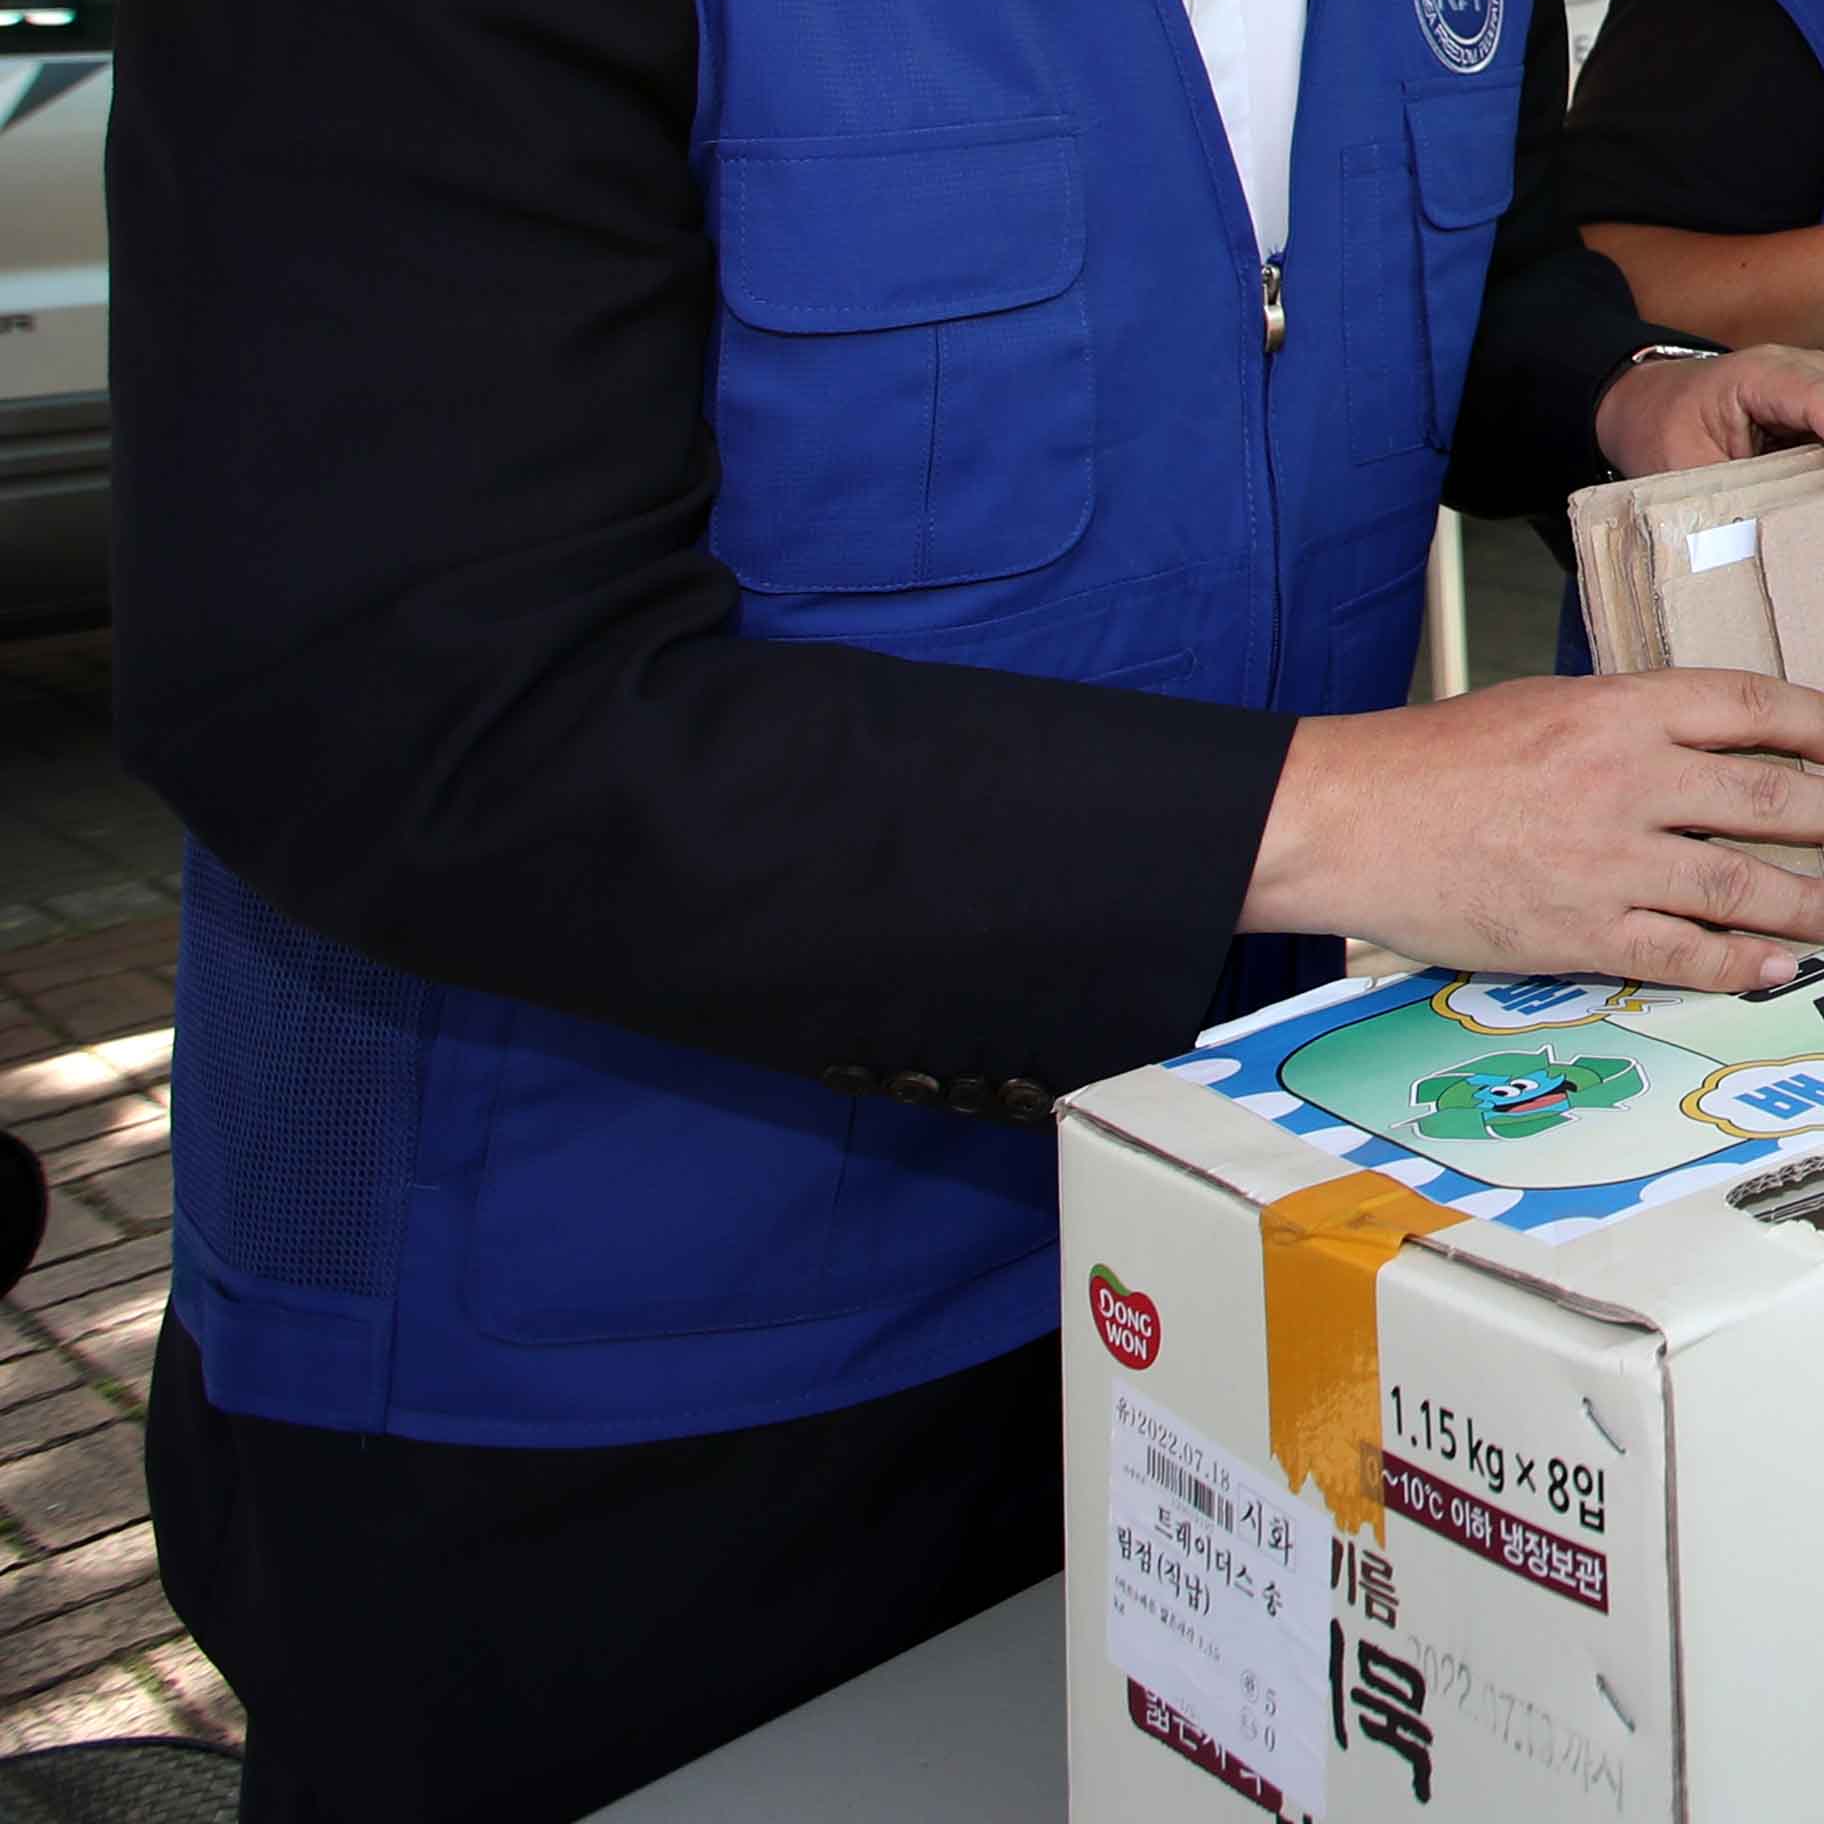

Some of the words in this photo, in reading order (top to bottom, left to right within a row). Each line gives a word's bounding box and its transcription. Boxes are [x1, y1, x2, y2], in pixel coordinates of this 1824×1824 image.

[1099, 1288, 1153, 1338] DONG
[1105, 1319, 1147, 1361] WON
[1239, 1498, 1294, 1568] 시화
[1547, 1457, 1606, 1535] 8입
[1154, 1506, 1256, 1599] 트레이더스
[1450, 1496, 1494, 1549] 이하
[1500, 1517, 1604, 1602] 냉장보관
